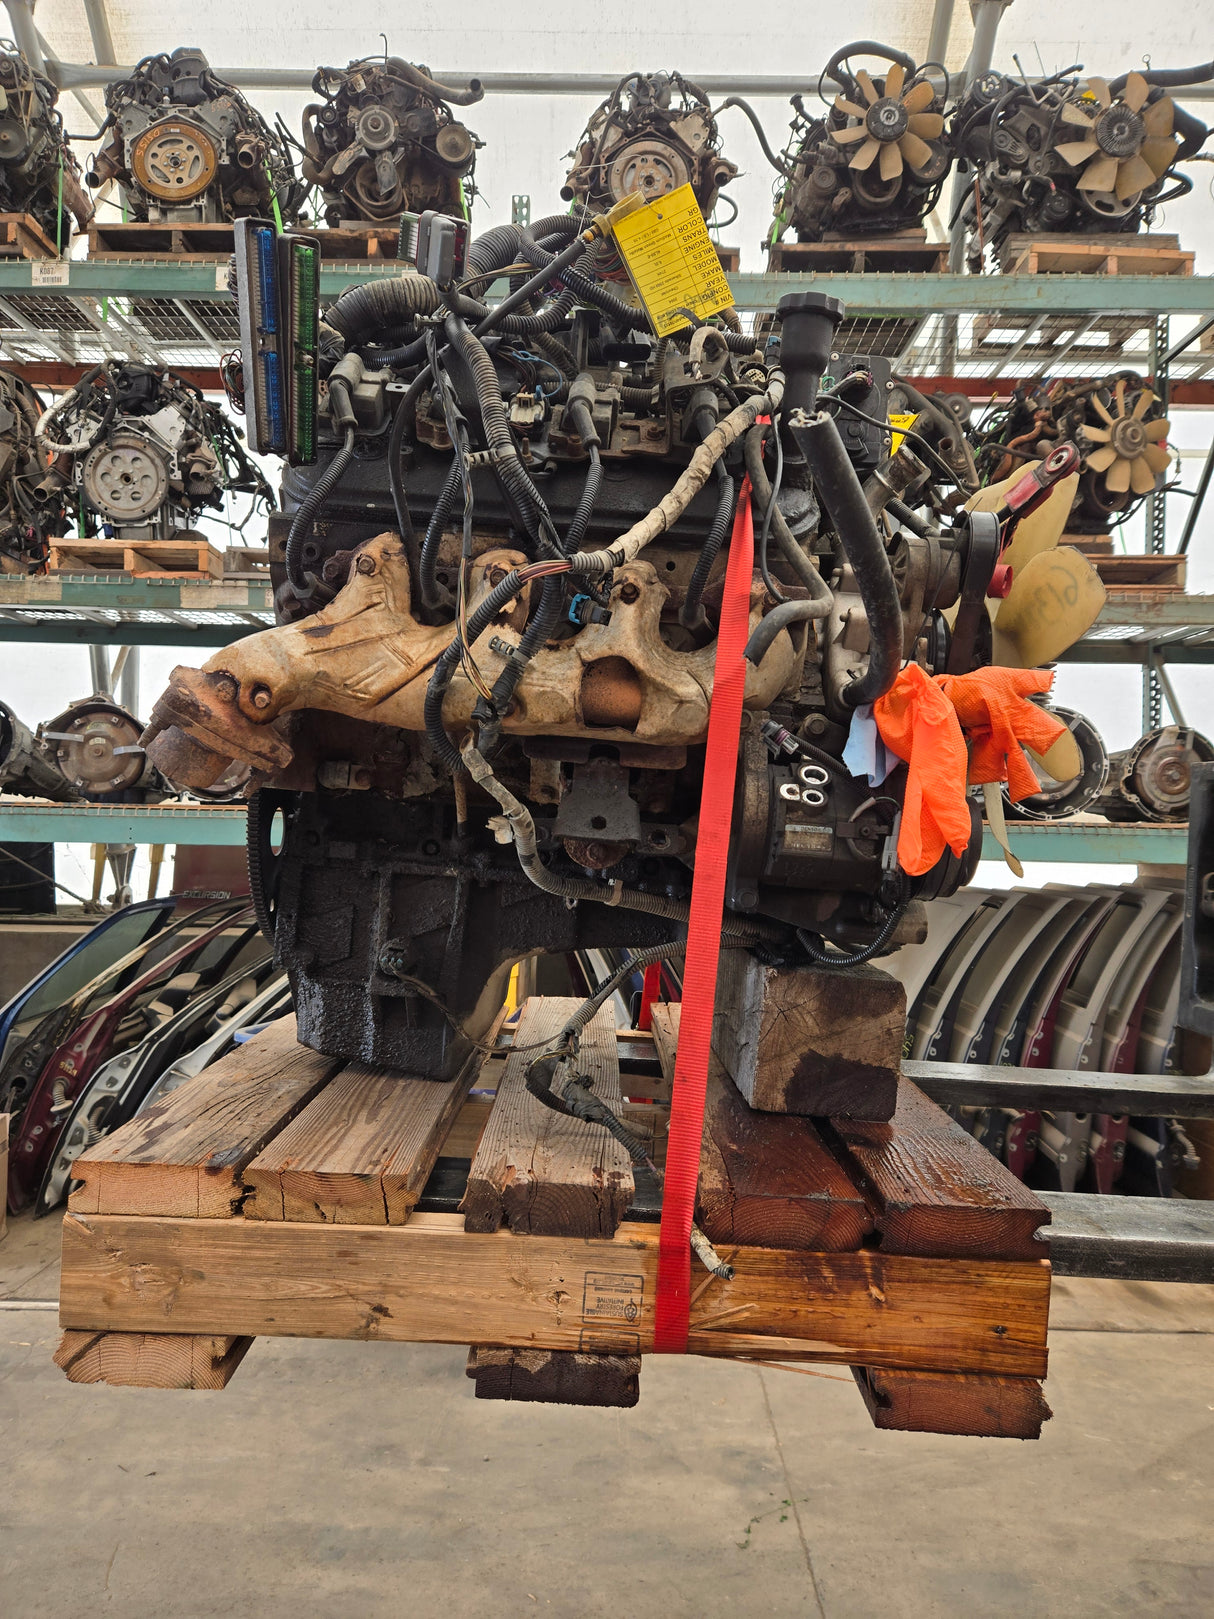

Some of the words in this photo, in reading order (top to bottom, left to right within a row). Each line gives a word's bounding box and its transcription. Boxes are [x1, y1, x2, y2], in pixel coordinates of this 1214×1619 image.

[686, 206, 699, 216] GR
[676, 216, 703, 233] COLOR
[681, 226, 706, 242] TRANS
[682, 236, 710, 253] ENGINE
[691, 245, 714, 260] MILES
[692, 255, 718, 271] MODEL
[700, 265, 721, 279] MAKE
[705, 274, 725, 287] YEAR
[701, 283, 729, 300] CONFIG
[719, 292, 732, 302] VIN
[182, 890, 232, 899] EXCURSION
[585, 1308, 623, 1317] SUSTAINABLE
